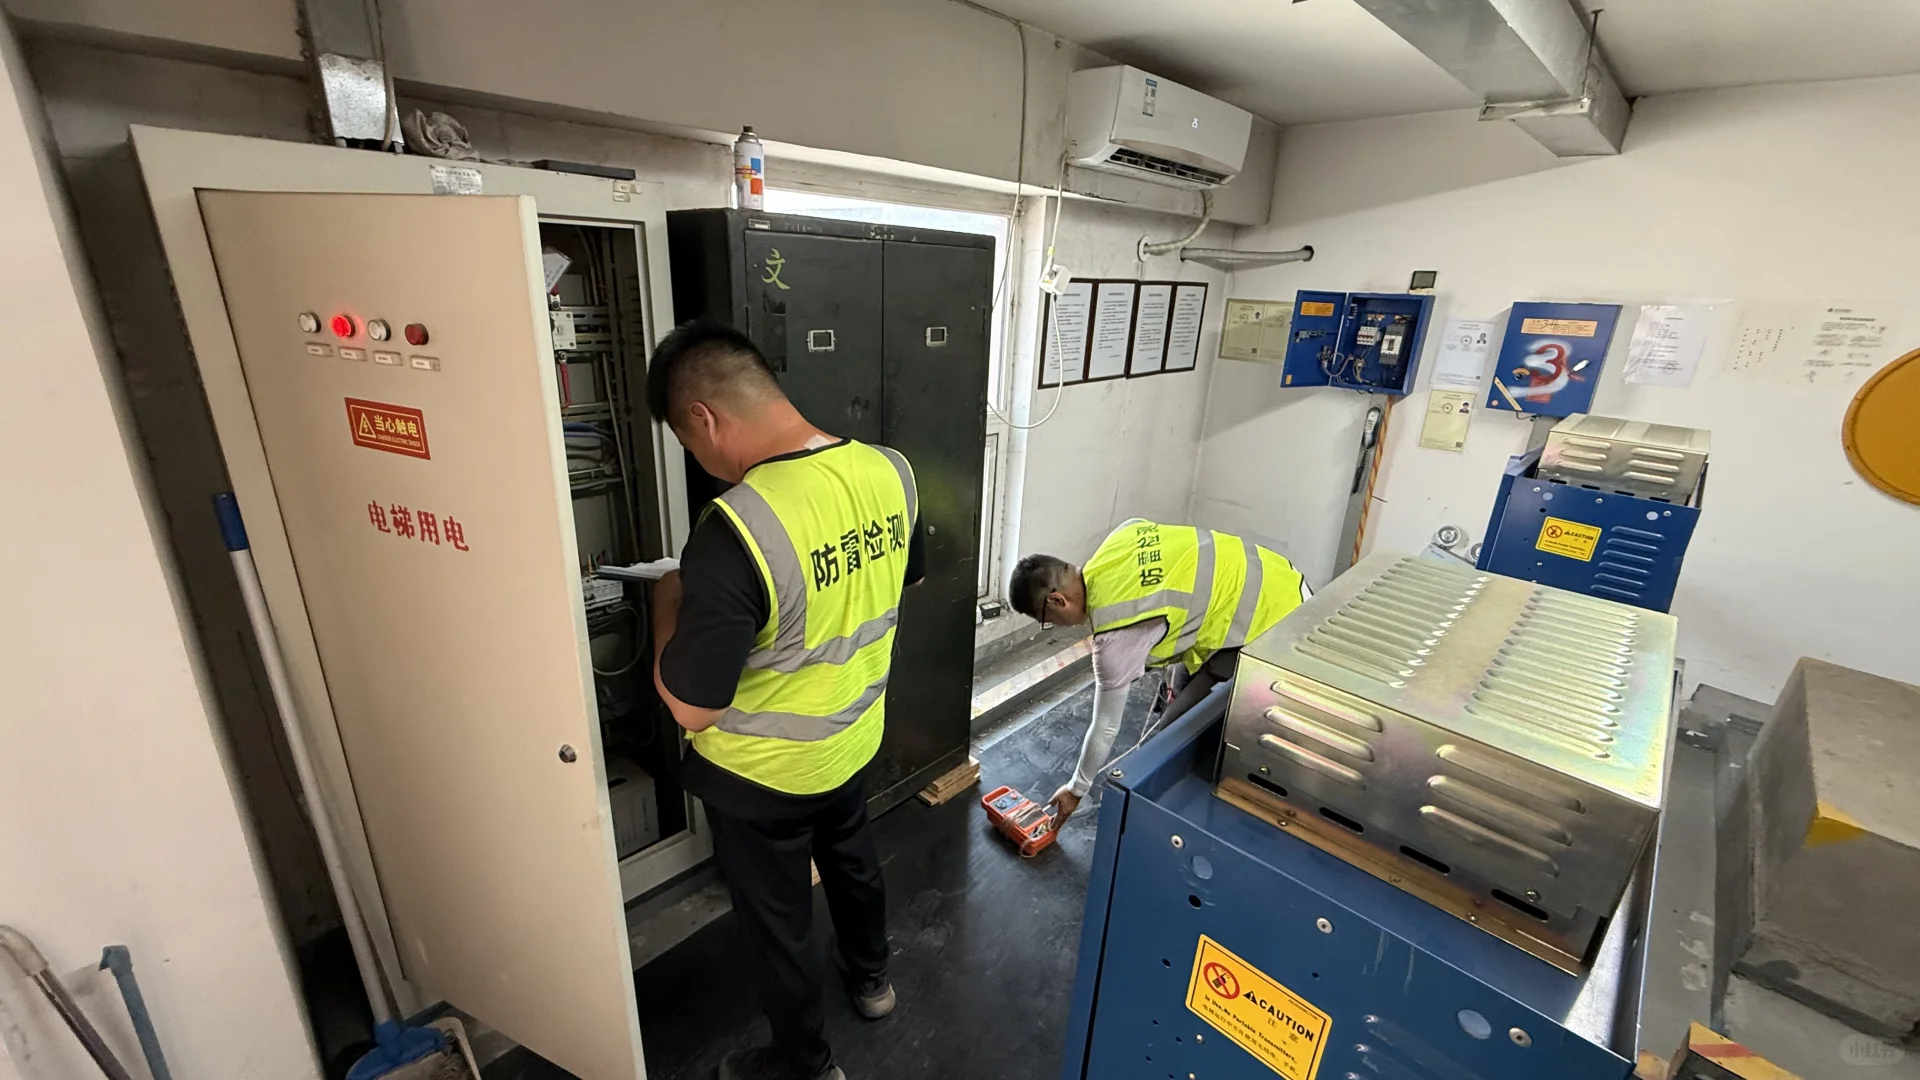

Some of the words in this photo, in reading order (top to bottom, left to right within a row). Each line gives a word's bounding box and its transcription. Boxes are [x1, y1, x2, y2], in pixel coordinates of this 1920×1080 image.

[761, 248, 791, 289] 文
[374, 415, 419, 438] 当心触电
[367, 500, 469, 552] 电梯用电
[1570, 531, 1595, 541] CAUTION
[810, 510, 906, 592] 防雷检测
[1232, 1014, 1256, 1034] Portable
[1258, 999, 1315, 1042] CAUTION
